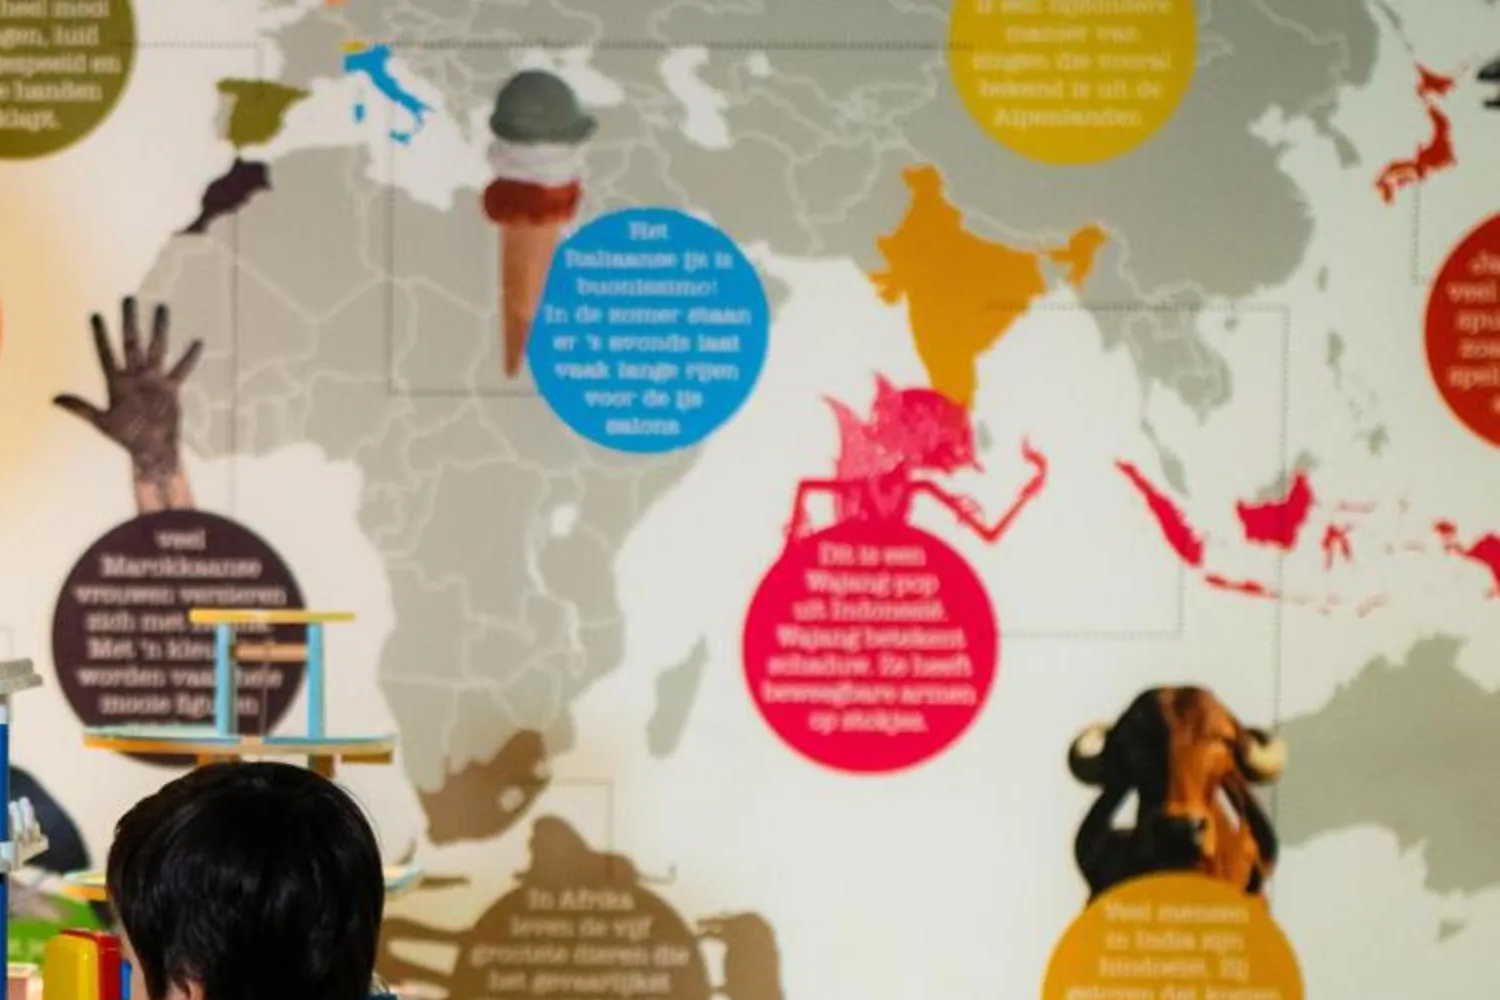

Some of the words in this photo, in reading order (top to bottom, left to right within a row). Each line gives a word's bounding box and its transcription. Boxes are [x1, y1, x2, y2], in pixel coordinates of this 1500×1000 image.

[1, 0, 46, 18] heel
[90, 57, 121, 74] en
[13, 80, 103, 101] handen
[979, 78, 1064, 98] bekend
[1136, 78, 1164, 99] de
[628, 221, 670, 241] Het
[564, 248, 677, 269] Italiaanse
[544, 304, 569, 324] In
[575, 304, 603, 324] de
[552, 335, 578, 352] er
[608, 332, 690, 352] avonds
[698, 332, 741, 352] laat
[553, 360, 610, 380] vaak
[617, 360, 679, 383] lange
[584, 391, 639, 409] voor
[641, 388, 671, 409] de
[817, 540, 854, 567] Dit
[857, 543, 880, 567] is
[883, 545, 927, 567] een
[101, 556, 262, 578] Marokkaanse
[75, 584, 176, 604] vrouwen
[179, 583, 289, 604] versieren
[792, 597, 828, 621] uit
[86, 612, 137, 632] zich
[141, 612, 186, 632] met
[87, 637, 138, 660] Met
[911, 651, 975, 678] heeft
[77, 666, 167, 688] worden
[171, 669, 218, 688] vaa
[101, 693, 172, 715] mooie
[900, 682, 979, 706] armen
[806, 710, 840, 737] op
[526, 888, 555, 911] In
[557, 887, 637, 911] Afrika
[509, 915, 575, 938] leven
[577, 915, 609, 938] de
[611, 914, 653, 943] vijf
[571, 943, 649, 967] dieren
[652, 943, 691, 967] die
[486, 969, 528, 993] het
[530, 969, 673, 999] gevaarlijkst
